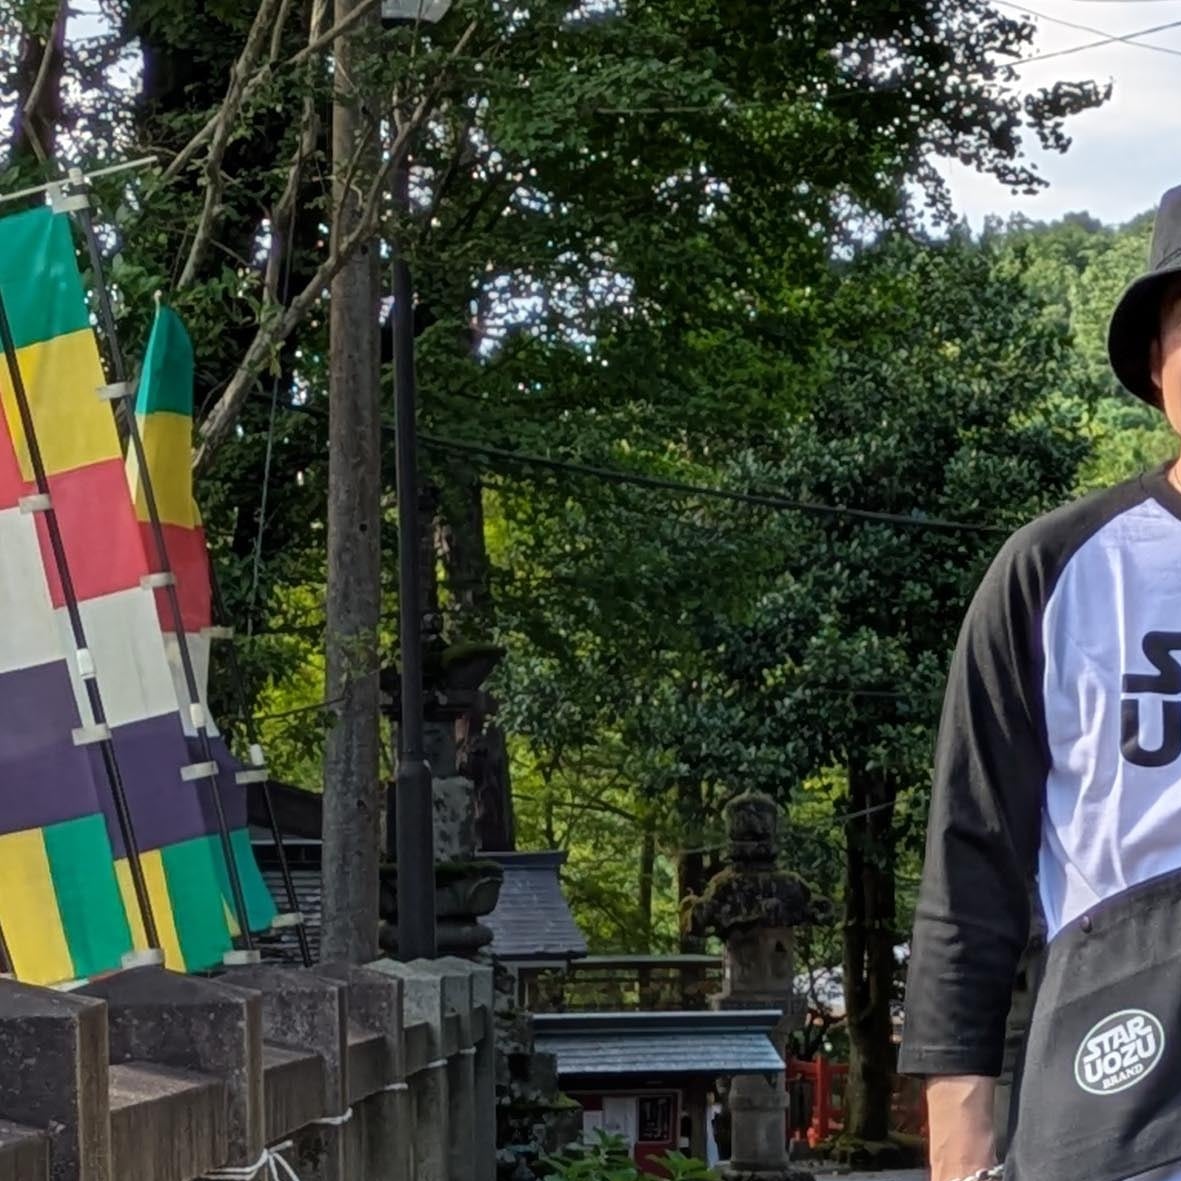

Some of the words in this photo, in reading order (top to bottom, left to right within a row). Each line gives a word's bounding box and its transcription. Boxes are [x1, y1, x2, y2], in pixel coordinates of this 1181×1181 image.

[1083, 1015, 1153, 1063] STAR
[1084, 1033, 1156, 1083] UOZU
[1102, 1063, 1144, 1090] BRAND
